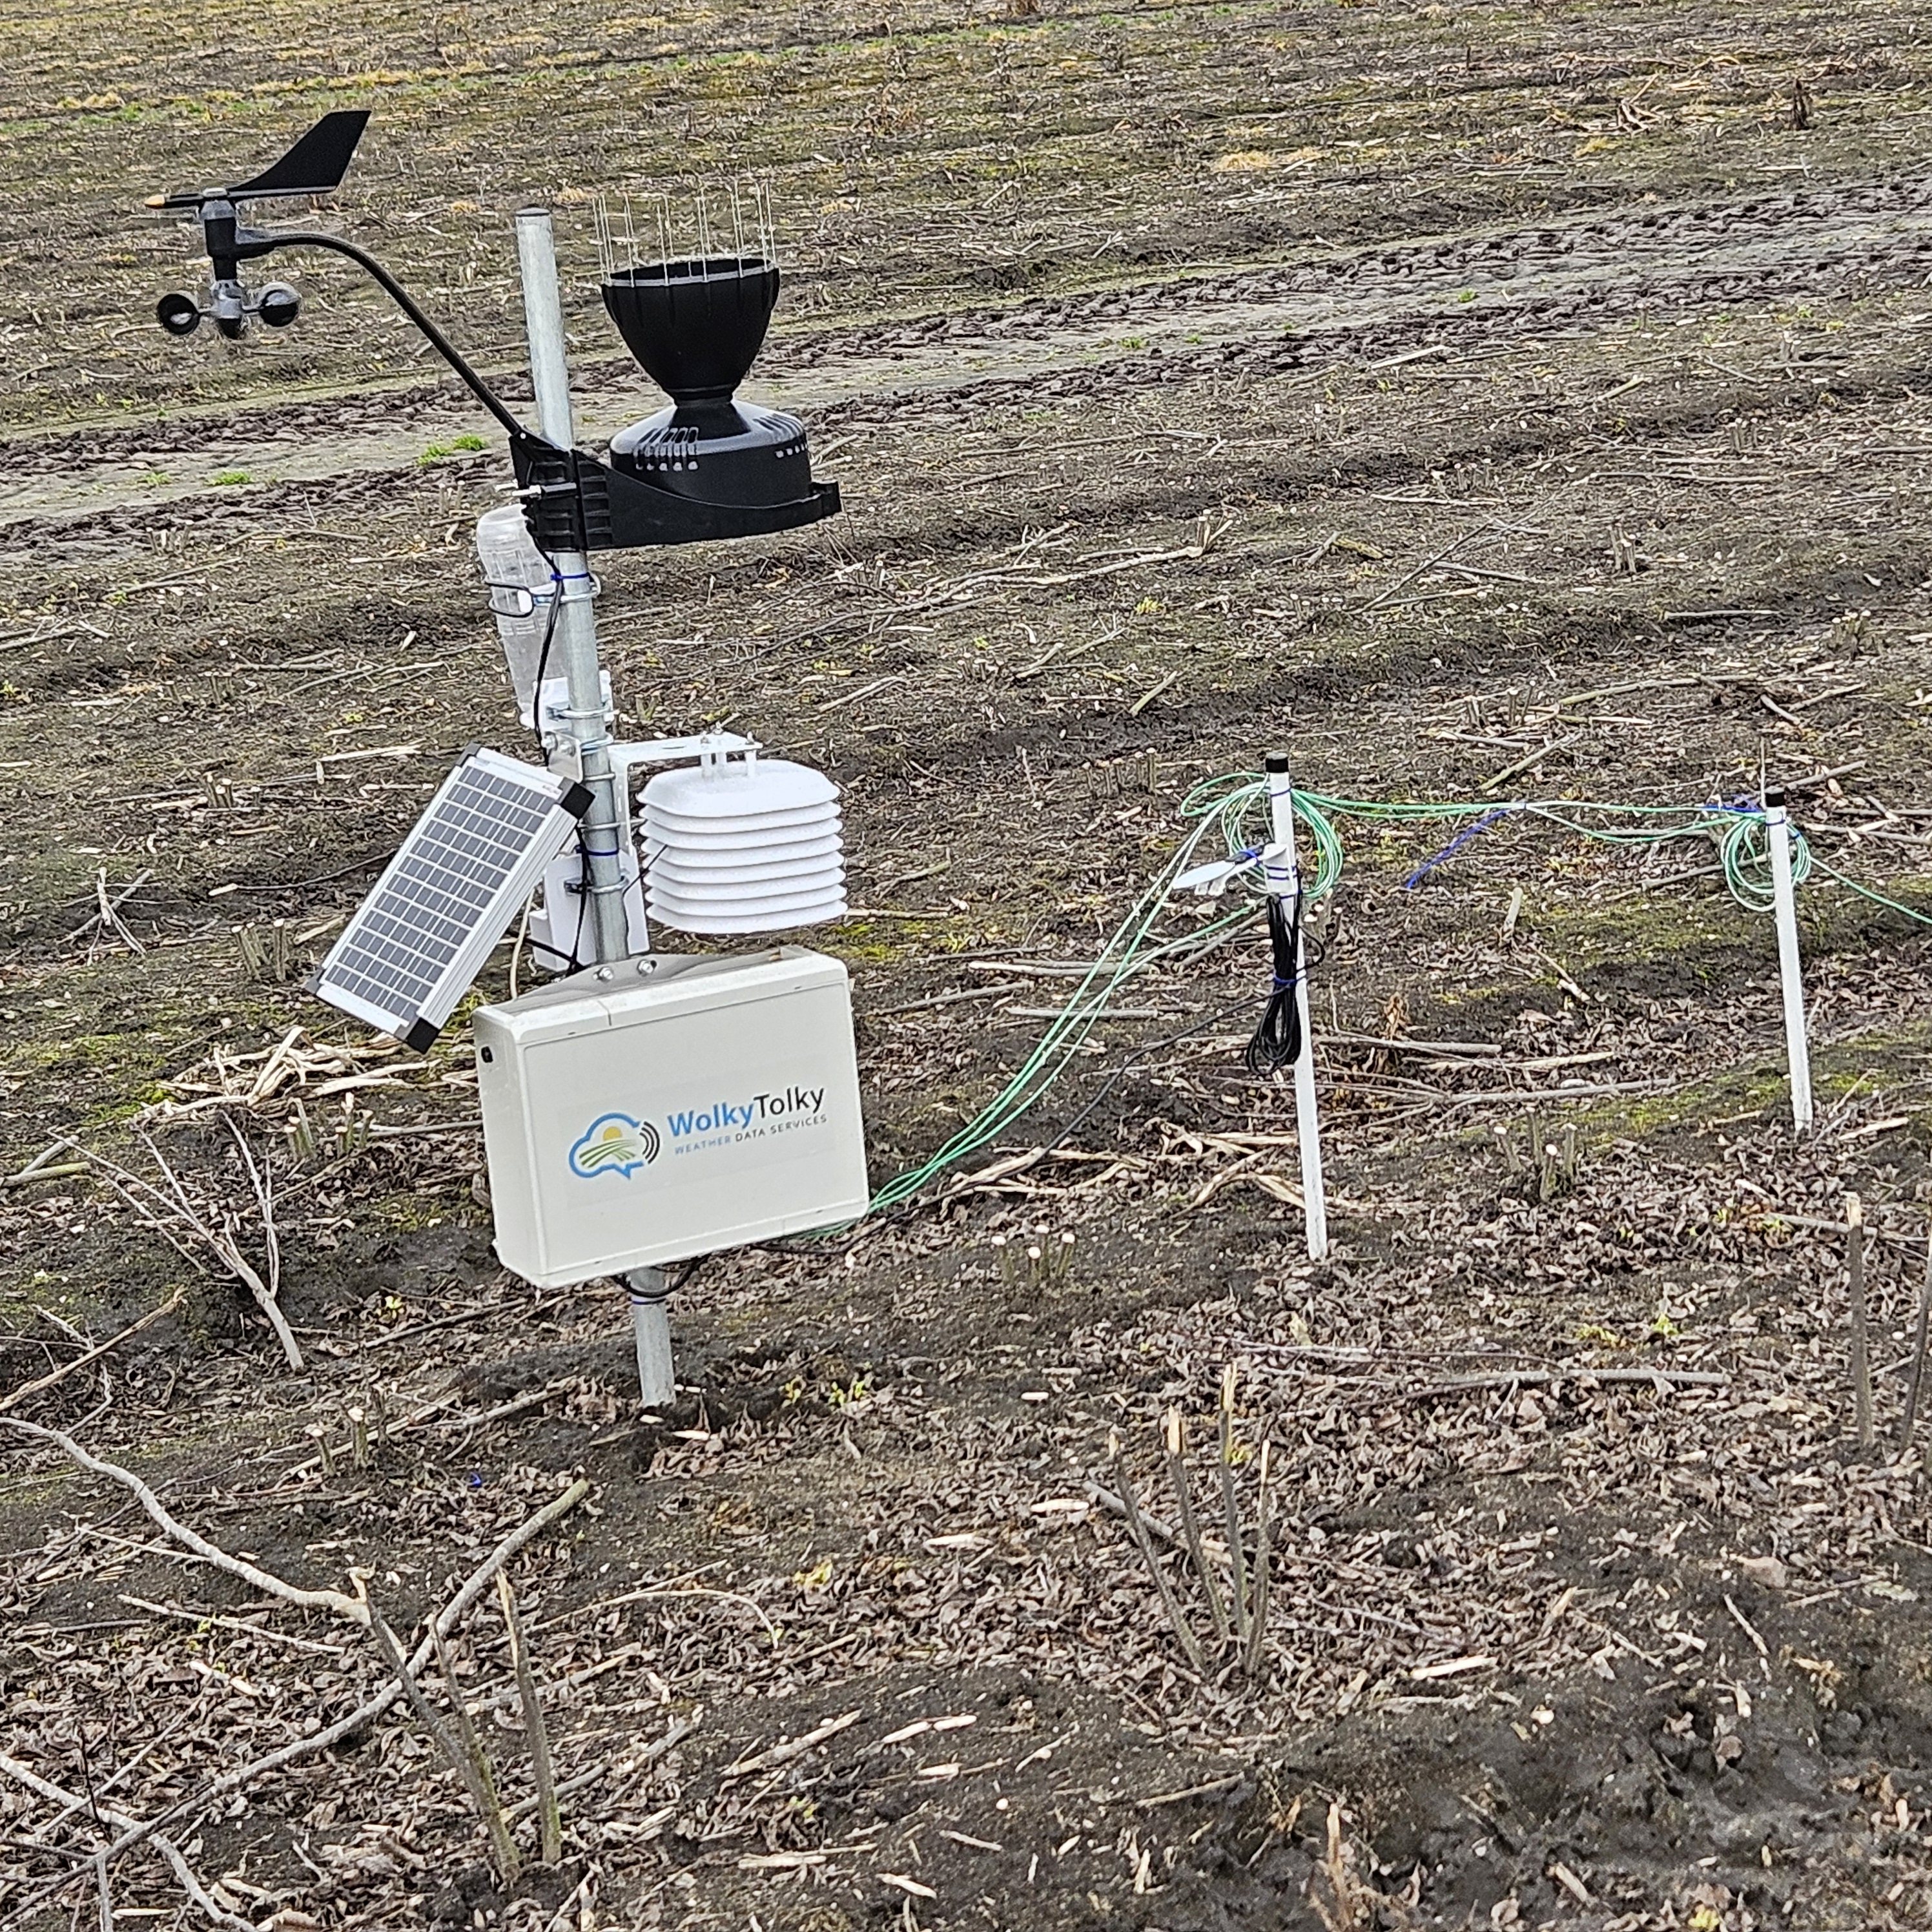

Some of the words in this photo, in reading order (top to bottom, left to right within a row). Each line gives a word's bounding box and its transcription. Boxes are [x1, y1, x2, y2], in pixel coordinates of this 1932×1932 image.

[667, 1086, 825, 1136] WolkyTolky
[675, 1136, 731, 1155] WEATHER
[735, 1129, 766, 1142] DATA
[770, 1114, 827, 1135] SERVICES
